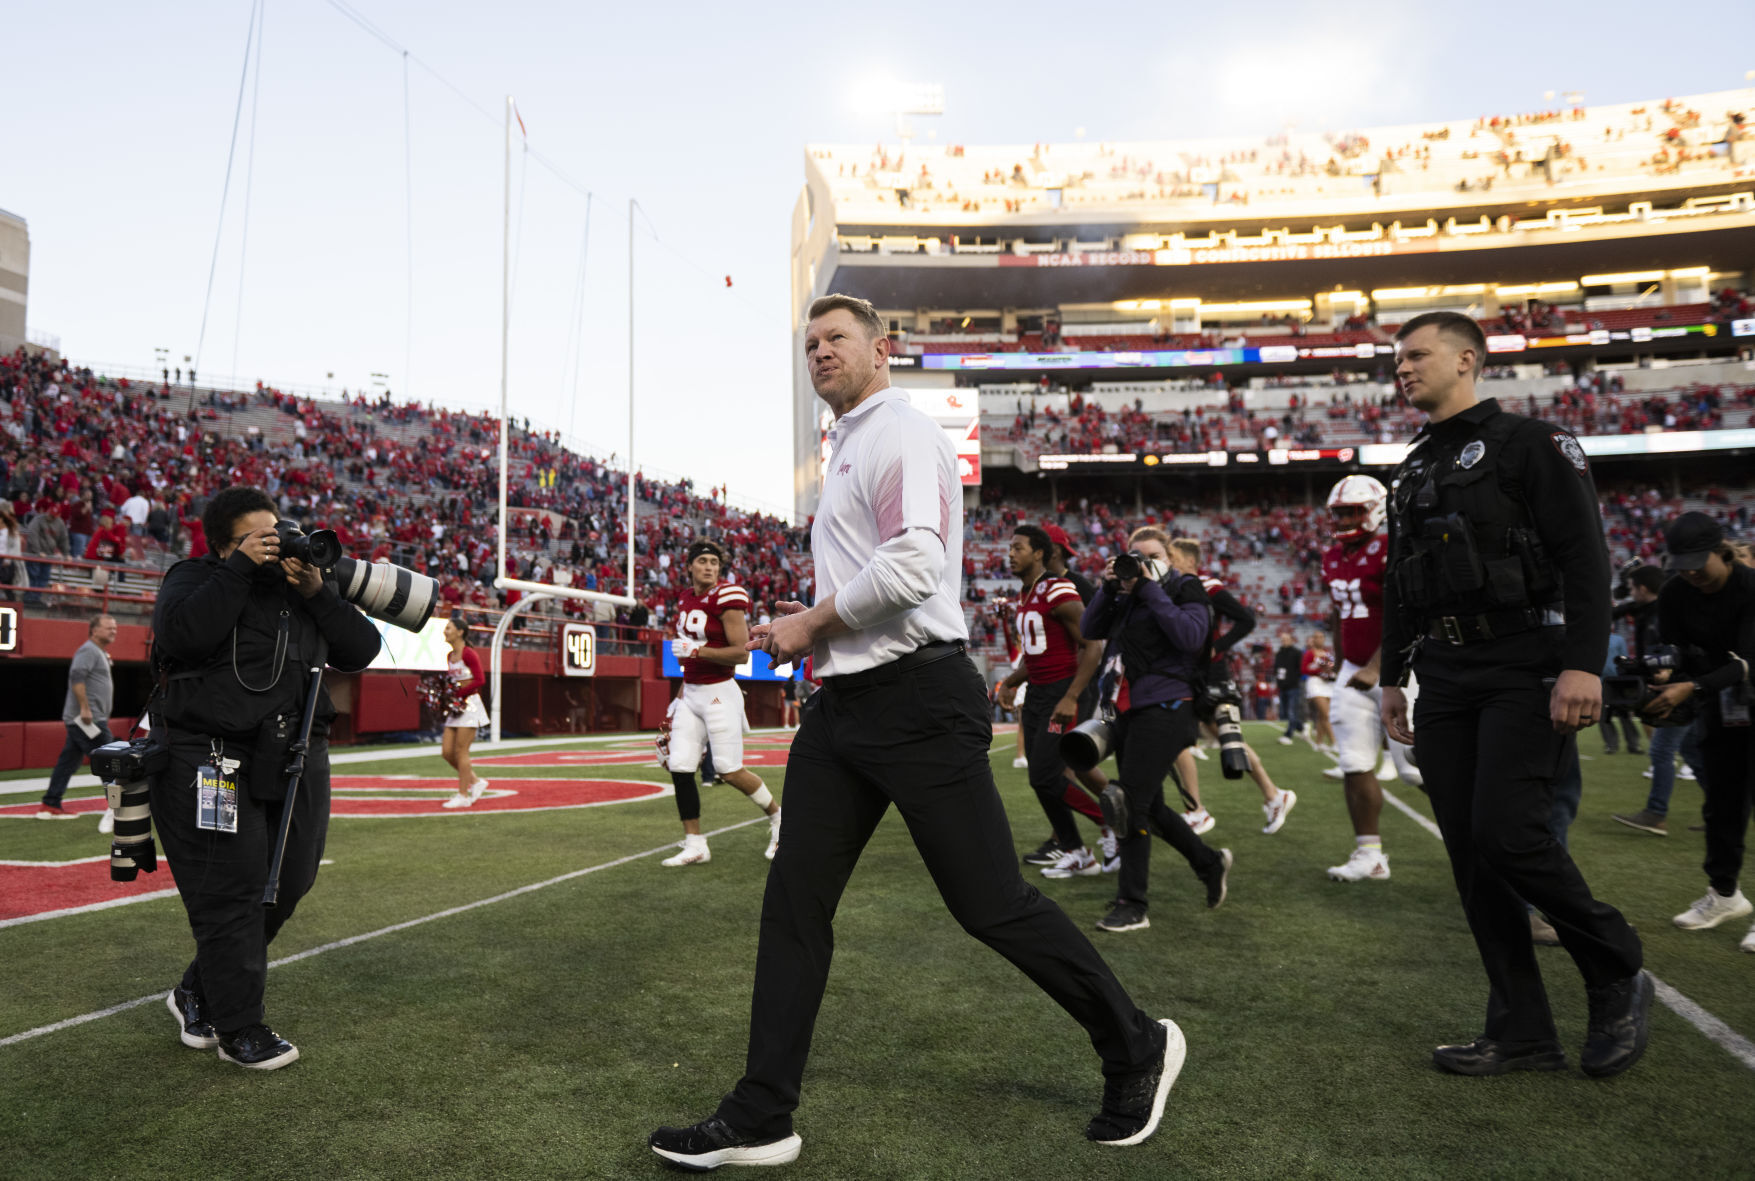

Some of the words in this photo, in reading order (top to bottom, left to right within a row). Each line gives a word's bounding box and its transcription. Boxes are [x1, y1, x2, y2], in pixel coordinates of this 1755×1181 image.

[1037, 252, 1083, 267] NCAA
[1088, 251, 1151, 265] RECORD
[568, 632, 592, 668] 40
[202, 777, 236, 791] MEDIA
